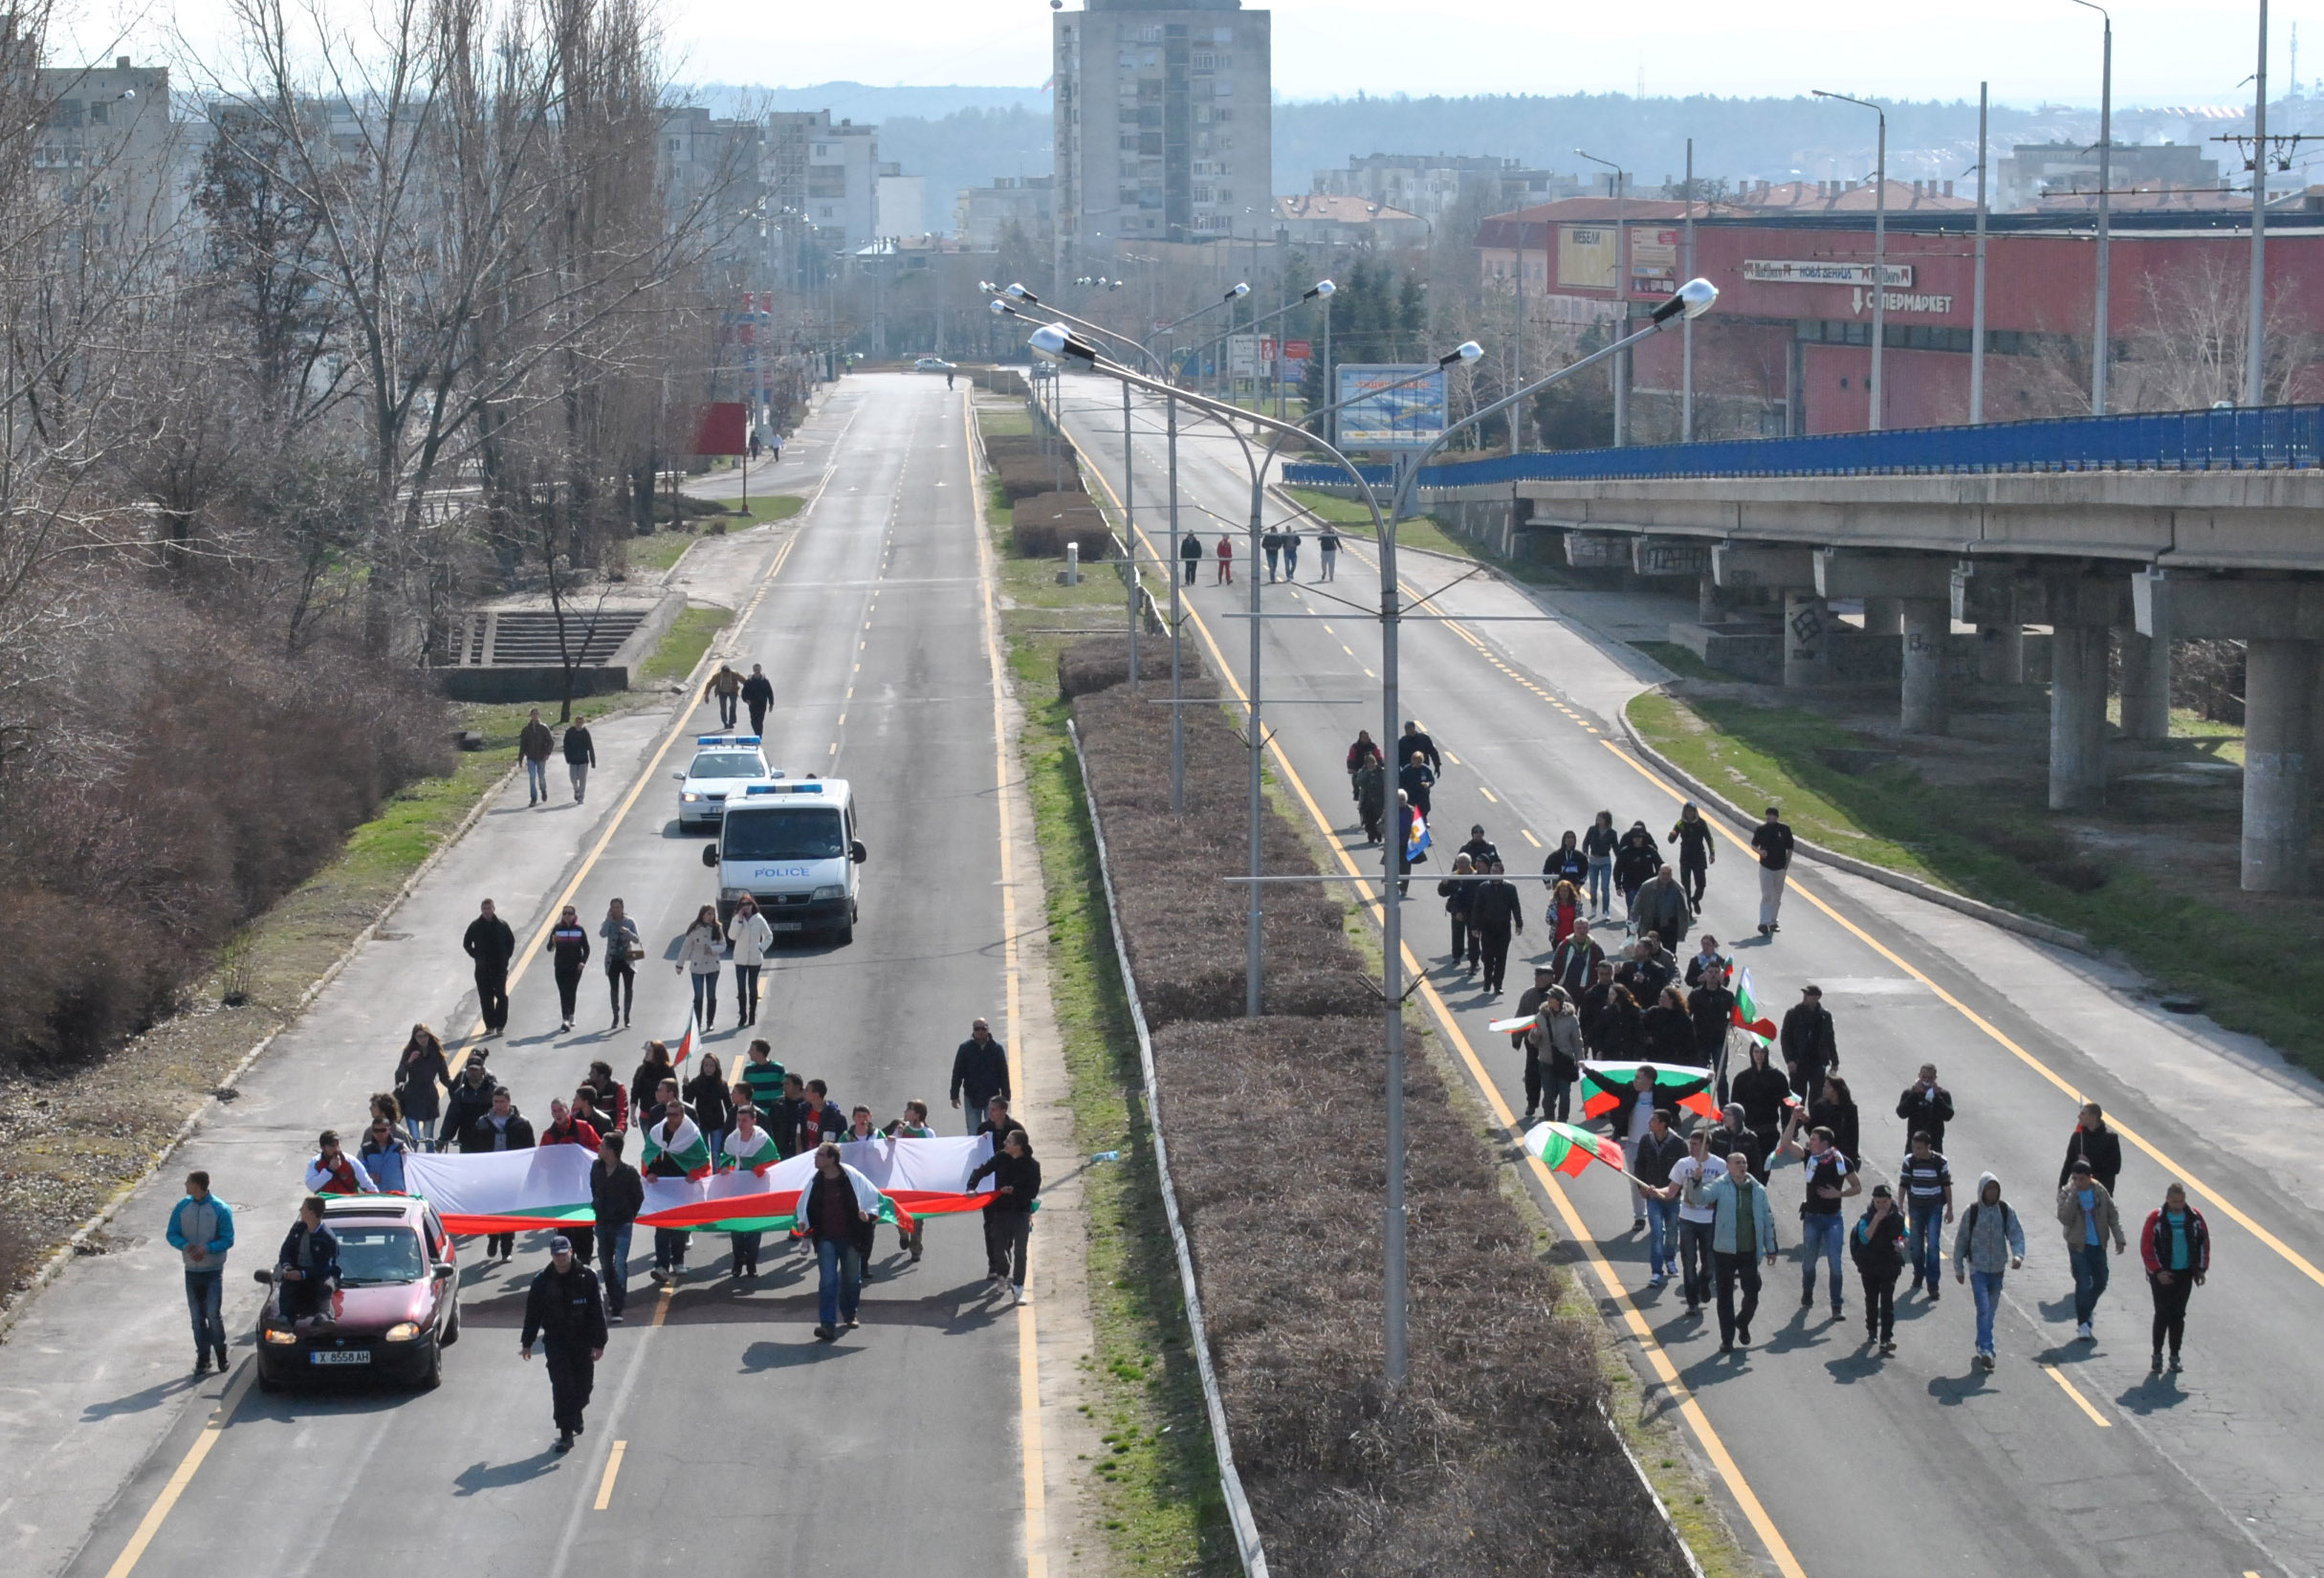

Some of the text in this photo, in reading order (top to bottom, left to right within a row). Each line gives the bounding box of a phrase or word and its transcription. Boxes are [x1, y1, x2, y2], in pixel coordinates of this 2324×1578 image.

[1572, 230, 1600, 245] МЕБЕЛИ
[1866, 292, 1952, 314] СПЕРМАРКЕТ
[755, 867, 811, 878] POLICE
[319, 1352, 369, 1363] X 8558 AH
